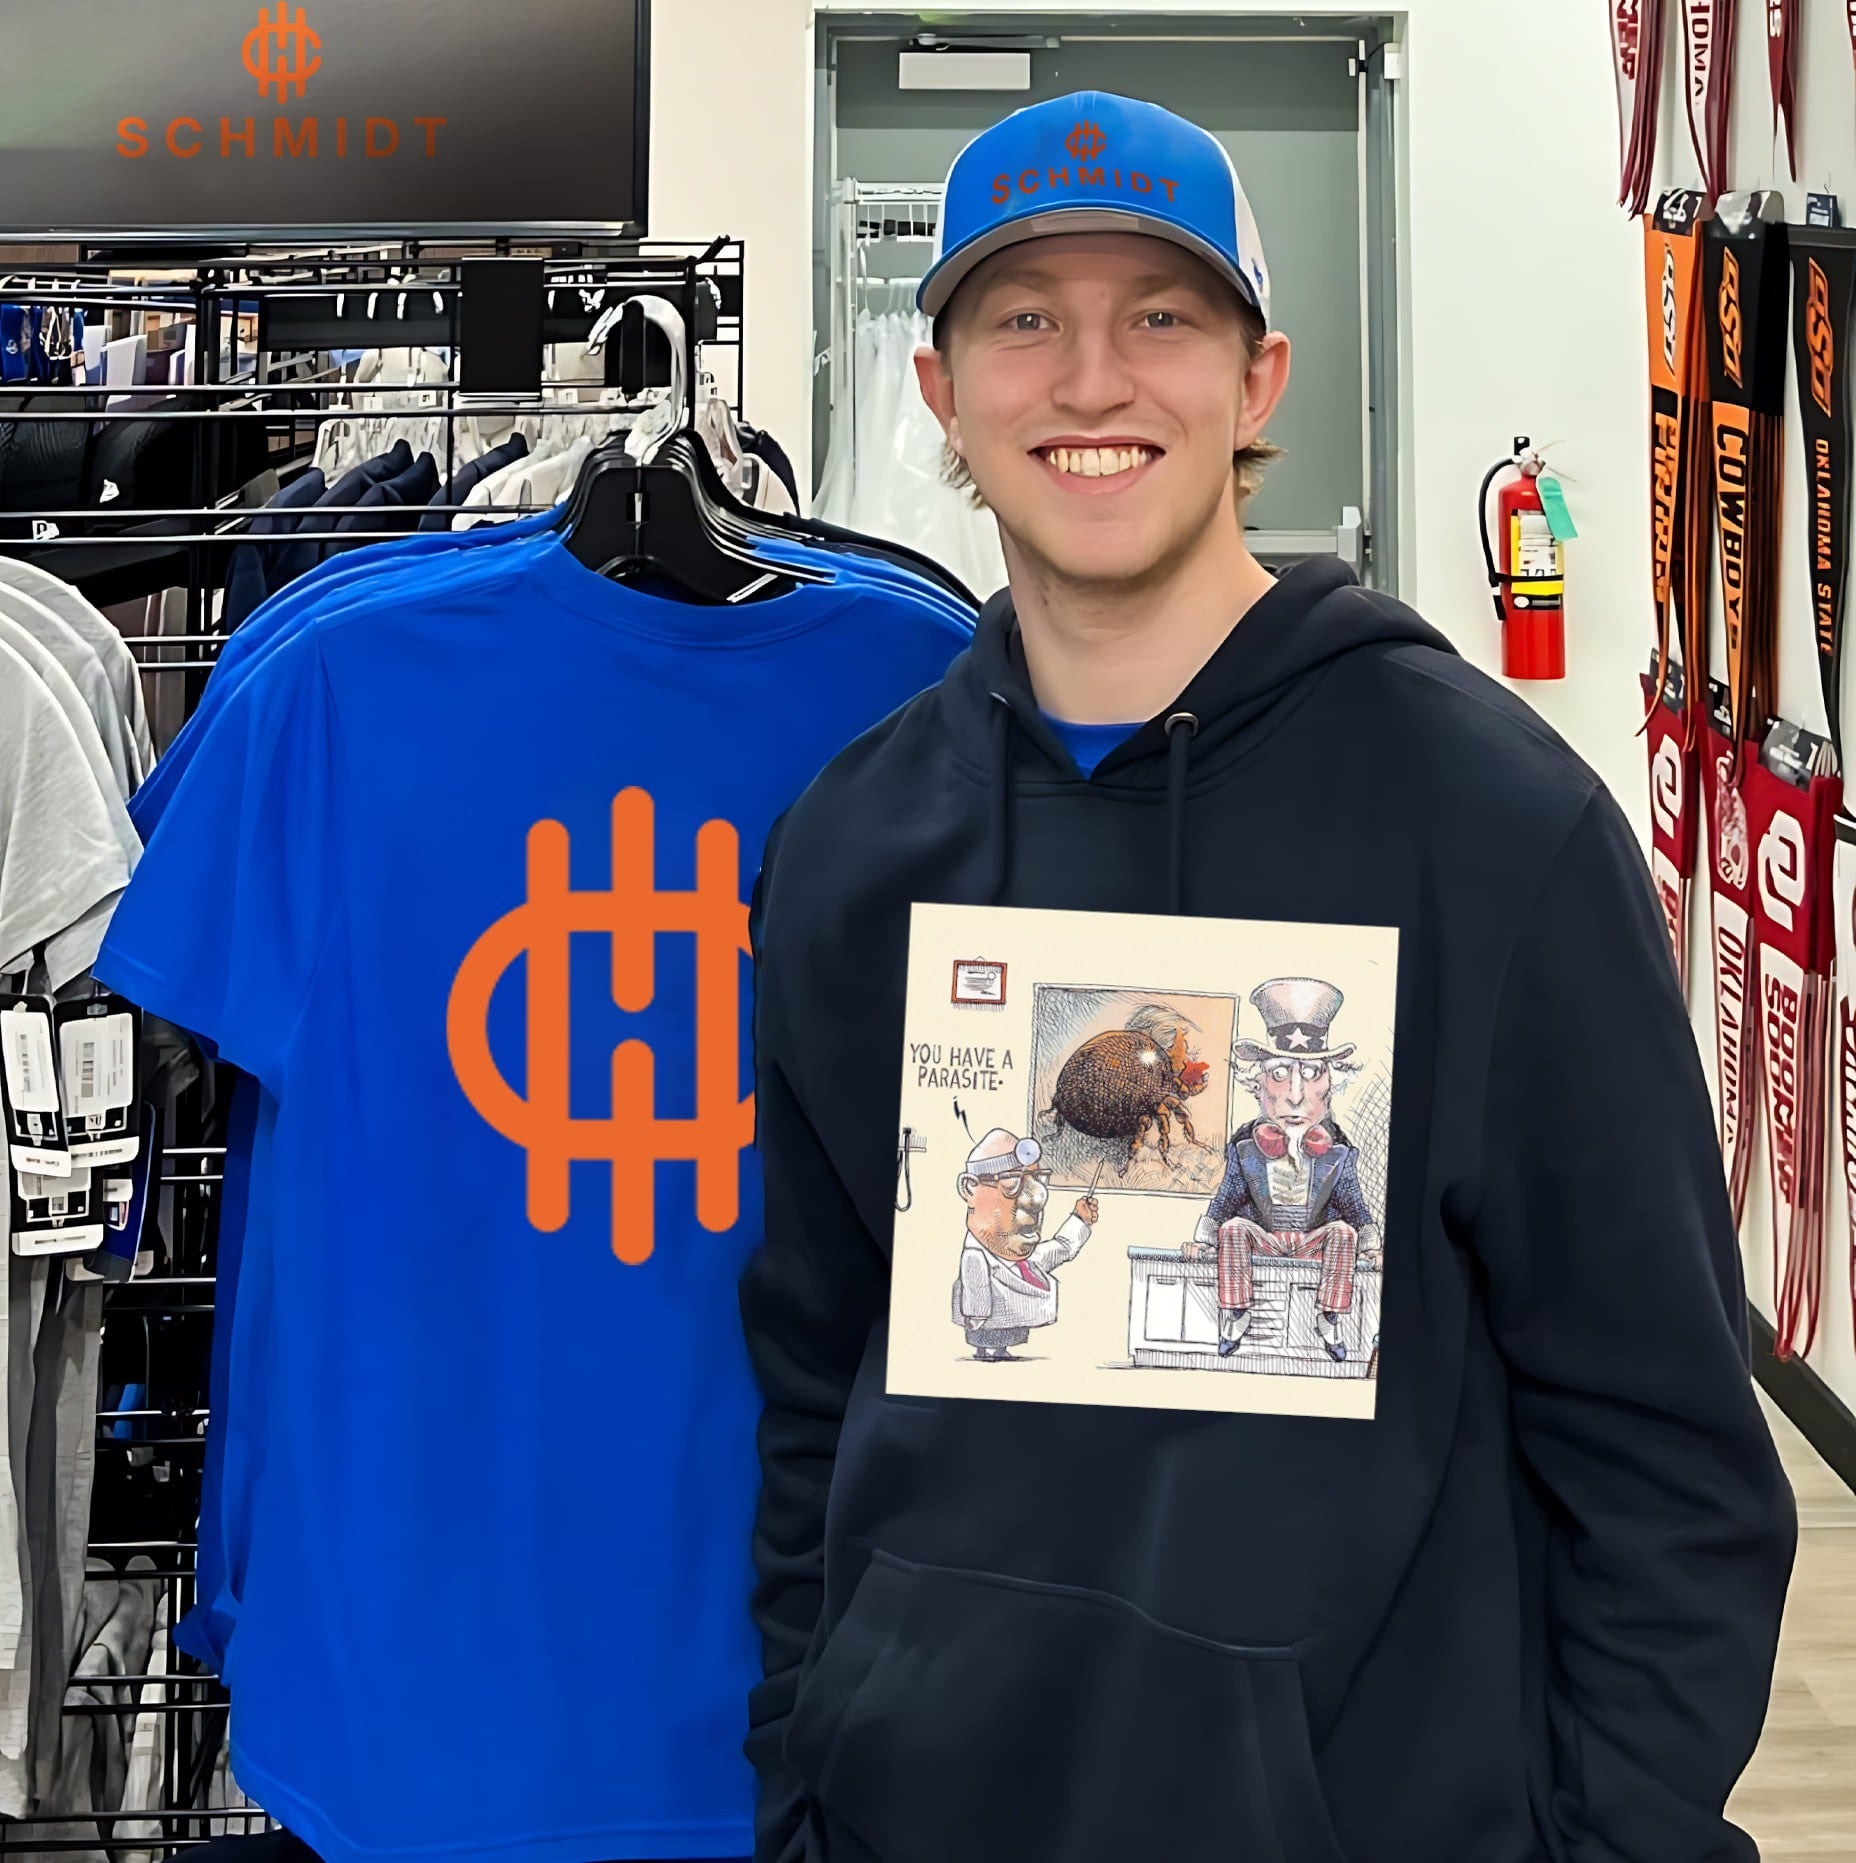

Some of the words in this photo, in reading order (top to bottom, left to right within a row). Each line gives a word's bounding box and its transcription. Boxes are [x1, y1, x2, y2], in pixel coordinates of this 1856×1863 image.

[116, 116, 447, 159] SCHMIDT
[991, 167, 1179, 204] SCHMIDT
[1815, 438, 1832, 570] OKLAHOMA
[910, 1043, 942, 1064] YOU
[950, 1046, 996, 1069] HAVE
[1002, 1049, 1014, 1070] A
[918, 1065, 1004, 1091] PARASITE.
